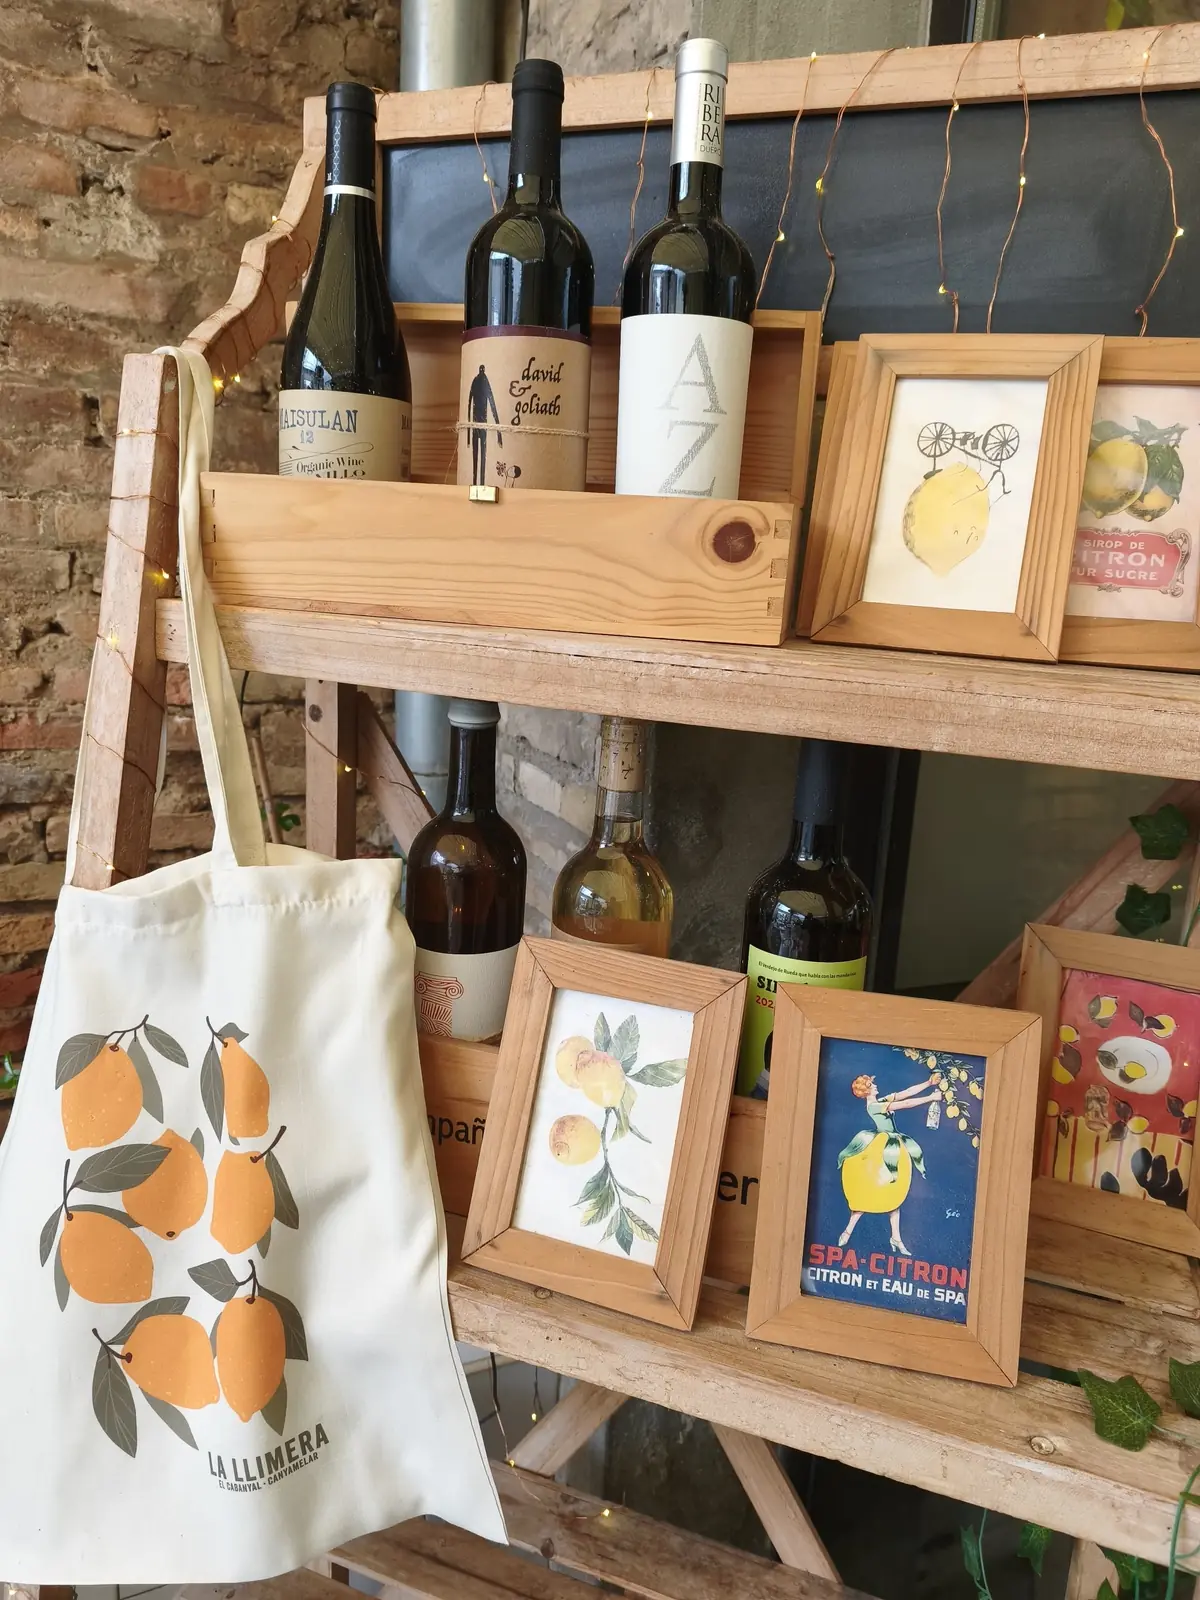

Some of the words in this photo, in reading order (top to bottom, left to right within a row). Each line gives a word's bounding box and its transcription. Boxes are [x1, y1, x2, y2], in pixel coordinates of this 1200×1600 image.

[703, 83, 720, 104] RI
[702, 104, 721, 124] BE
[701, 124, 720, 145] RA
[521, 357, 564, 383] david
[655, 333, 727, 415] A
[509, 380, 531, 397] &
[511, 393, 561, 426] goliath
[300, 430, 315, 444] 12
[296, 459, 334, 476] Organic
[336, 456, 365, 467] Wine
[1083, 539, 1123, 548] SIROP
[1129, 541, 1145, 550] DE
[1080, 550, 1165, 567] ITRON
[1074, 567, 1097, 577] UR
[1104, 569, 1158, 581] SUCRE
[756, 995, 776, 1010] 202
[807, 1267, 863, 1288] CITRON
[866, 1280, 879, 1290] ET
[882, 1279, 913, 1296] EAU
[917, 1288, 930, 1299] DE
[934, 1288, 967, 1306] SPA
[208, 1451, 227, 1480] LA
[231, 1423, 329, 1482] LLIMERA
[218, 1479, 226, 1489] EL
[226, 1481, 262, 1493] CABANYAL
[267, 1452, 319, 1486] CANYAMELAR
